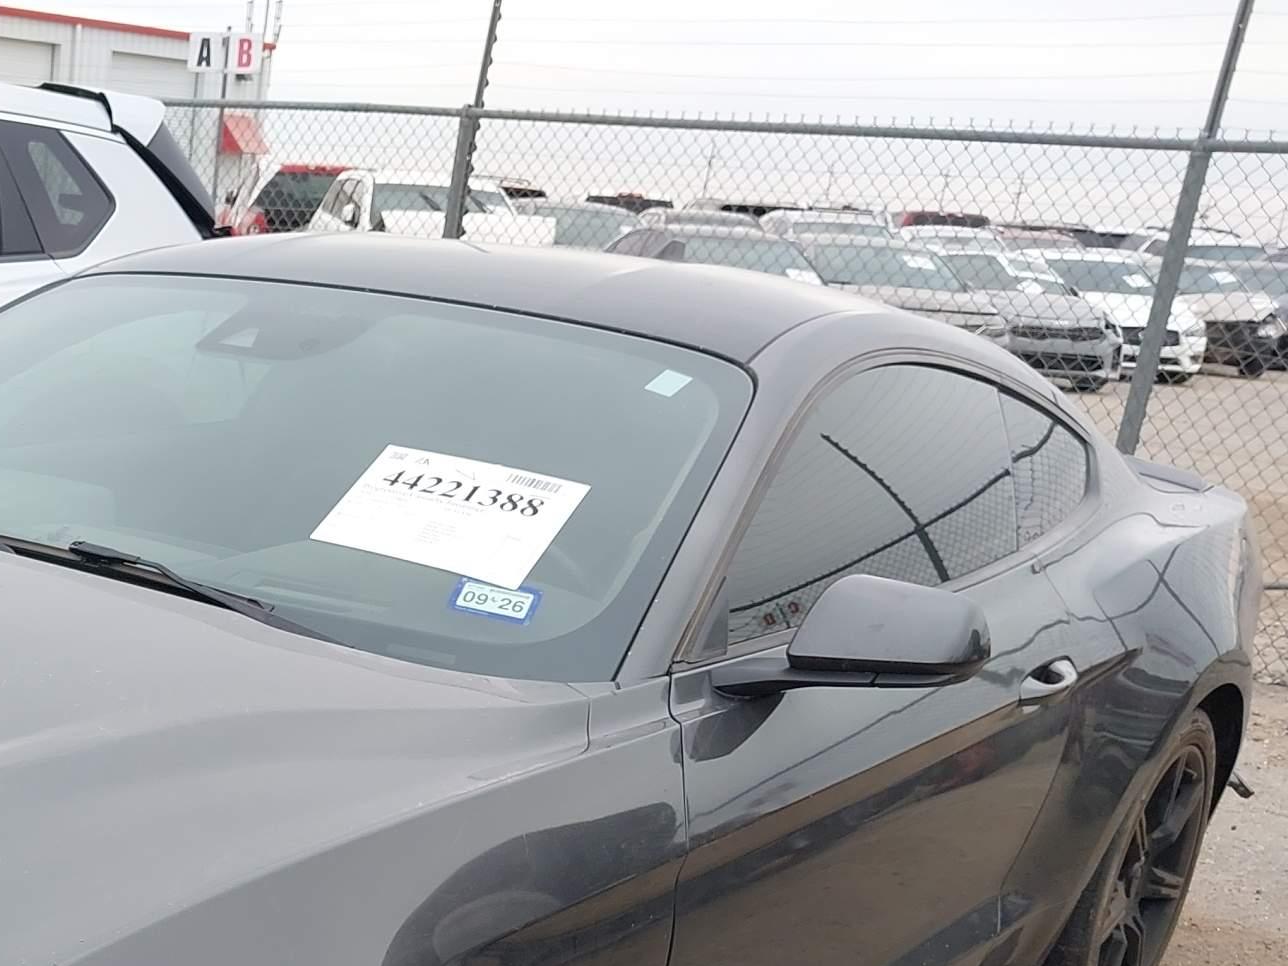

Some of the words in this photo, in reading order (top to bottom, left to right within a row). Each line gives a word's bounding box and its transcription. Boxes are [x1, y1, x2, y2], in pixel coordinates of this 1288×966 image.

[197, 37, 211, 67] A
[237, 38, 252, 67] B
[382, 469, 545, 518] 44221388
[463, 590, 489, 606] 09
[498, 597, 526, 614] 26
